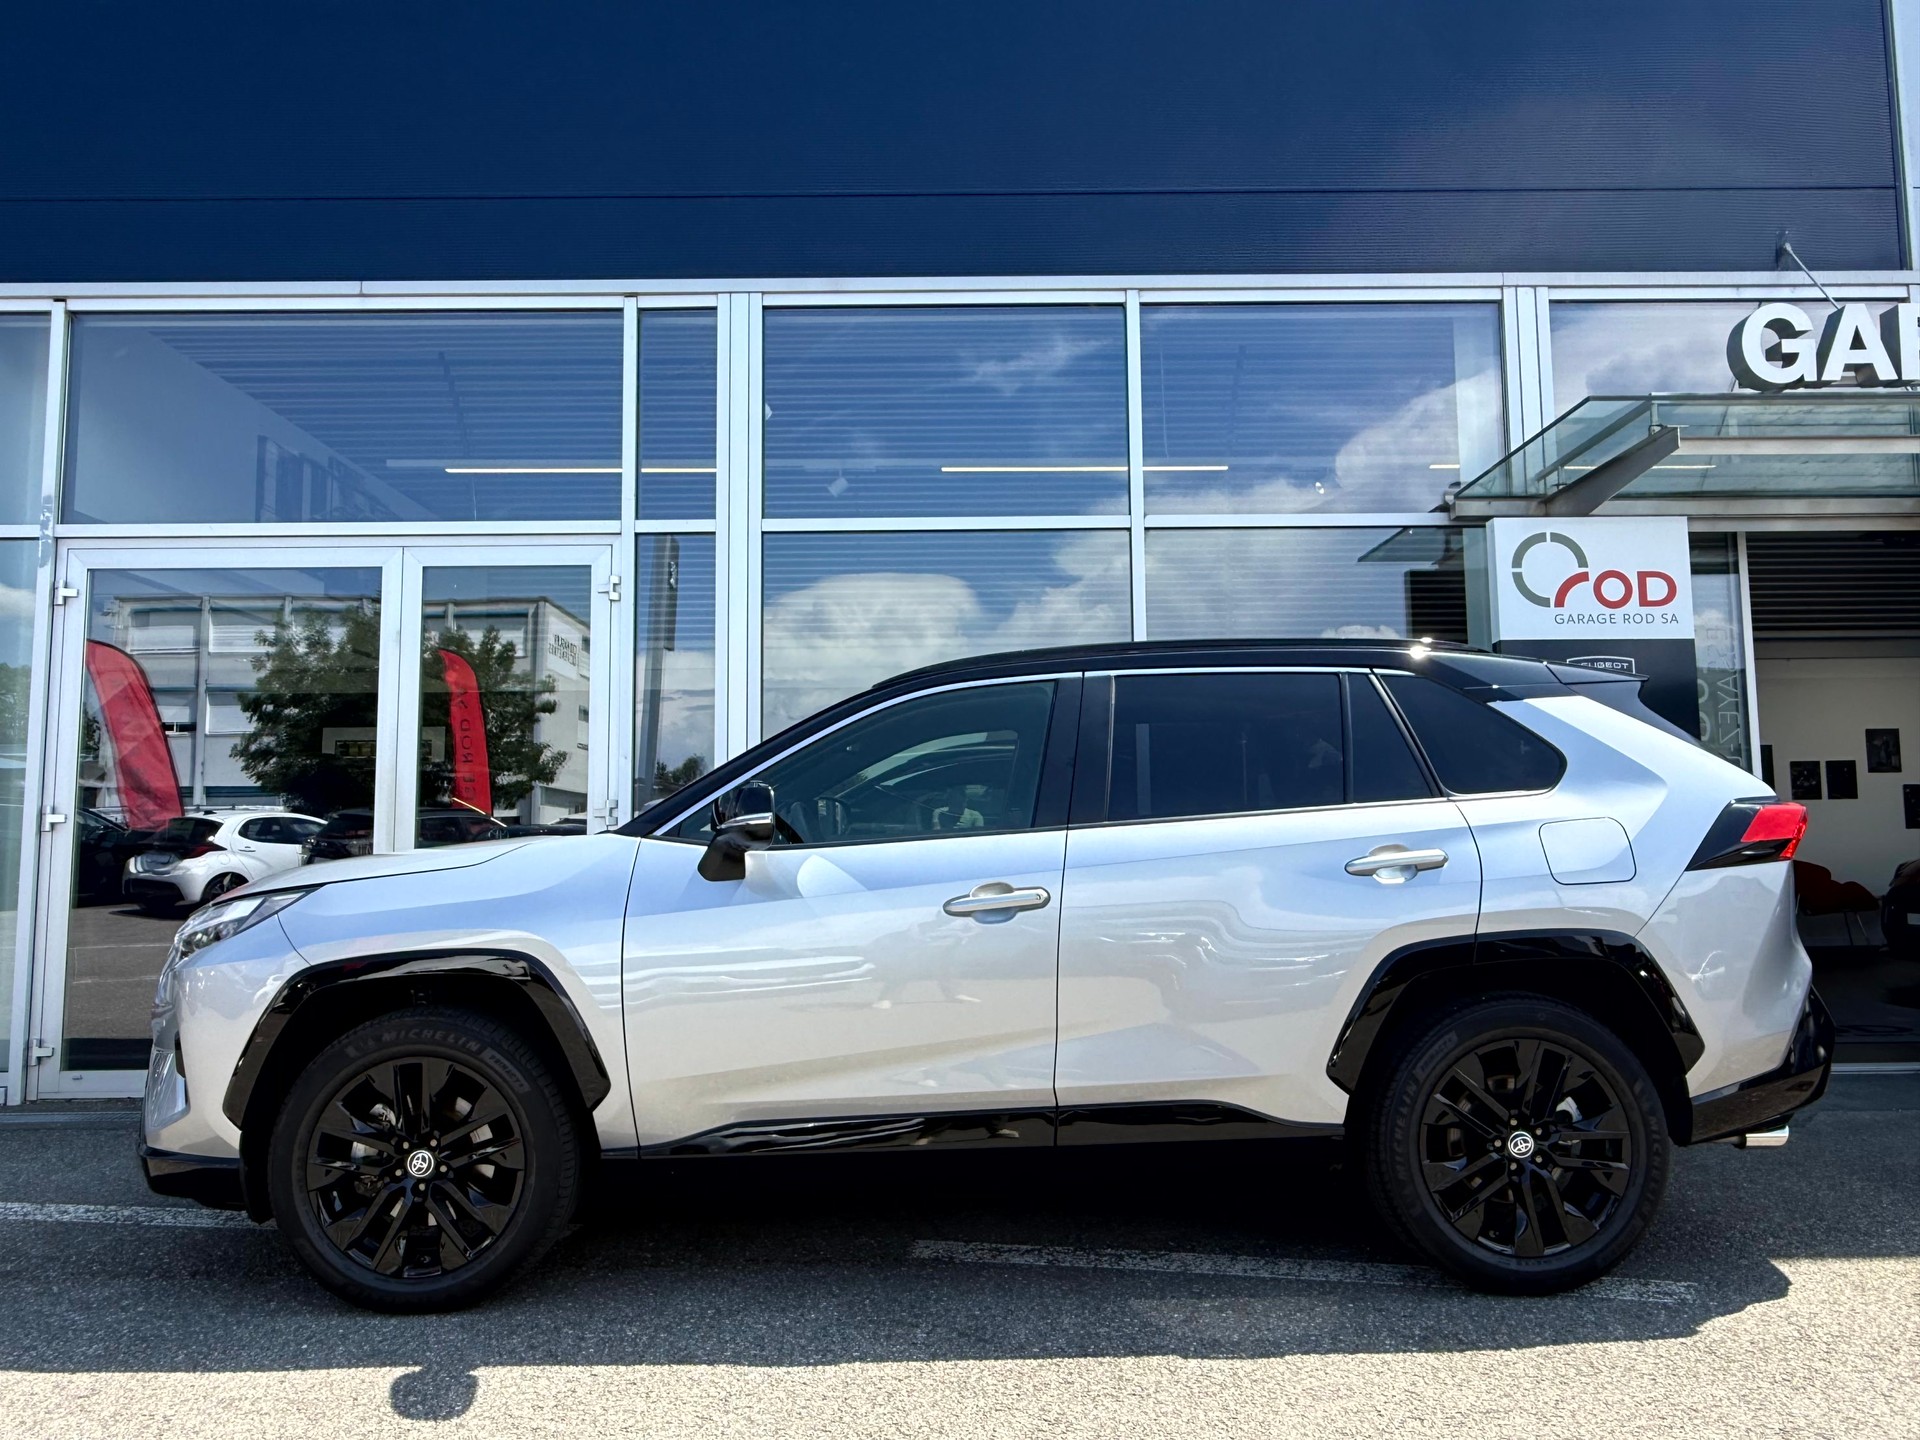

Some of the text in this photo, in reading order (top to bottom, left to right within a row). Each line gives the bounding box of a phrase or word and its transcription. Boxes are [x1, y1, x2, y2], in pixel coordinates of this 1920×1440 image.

[1554, 613, 1679, 625] GARAGE ROD SA
[381, 1027, 481, 1053] MICHELIN
[1392, 1080, 1418, 1180] MICHELIN
